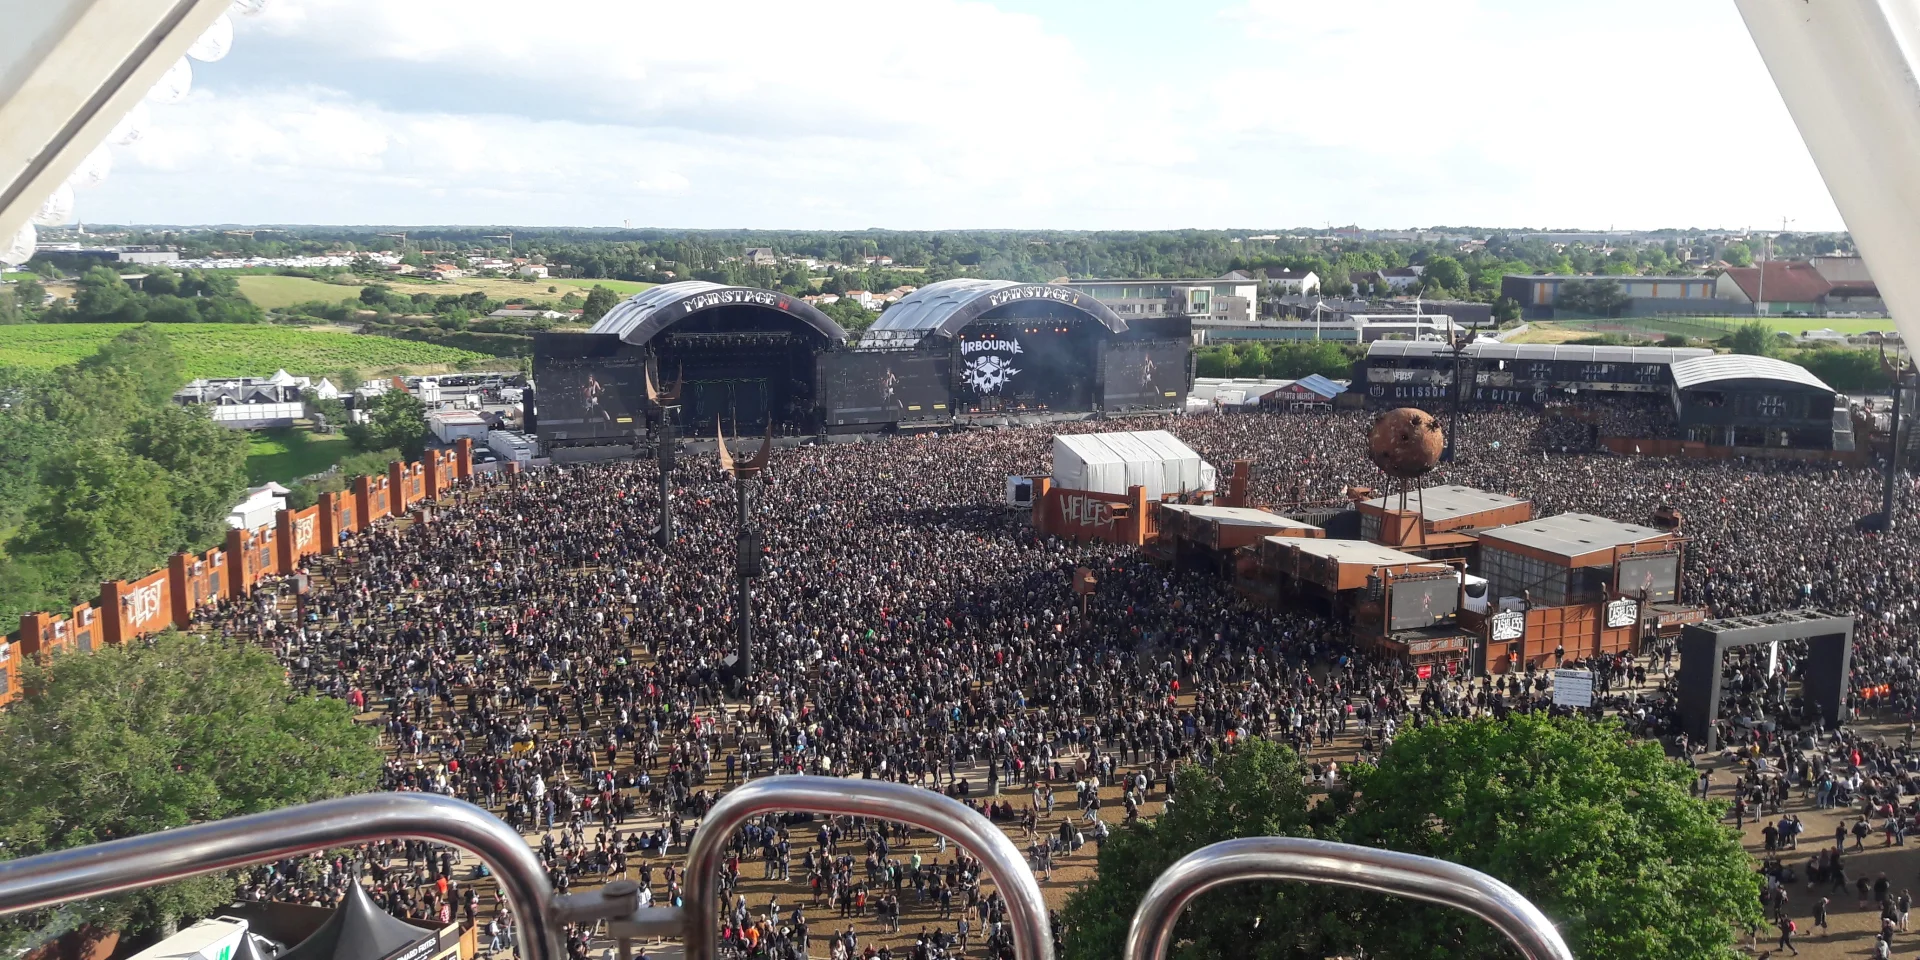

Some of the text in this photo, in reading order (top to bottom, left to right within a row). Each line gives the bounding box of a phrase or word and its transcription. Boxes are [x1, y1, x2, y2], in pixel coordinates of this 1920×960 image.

[682, 290, 776, 313] MAINSTAGE
[989, 286, 1071, 306] MAINSTAGE
[1395, 386, 1446, 398] CLISSON
[1492, 390, 1522, 402] CITY
[418, 937, 436, 953] FRITES
